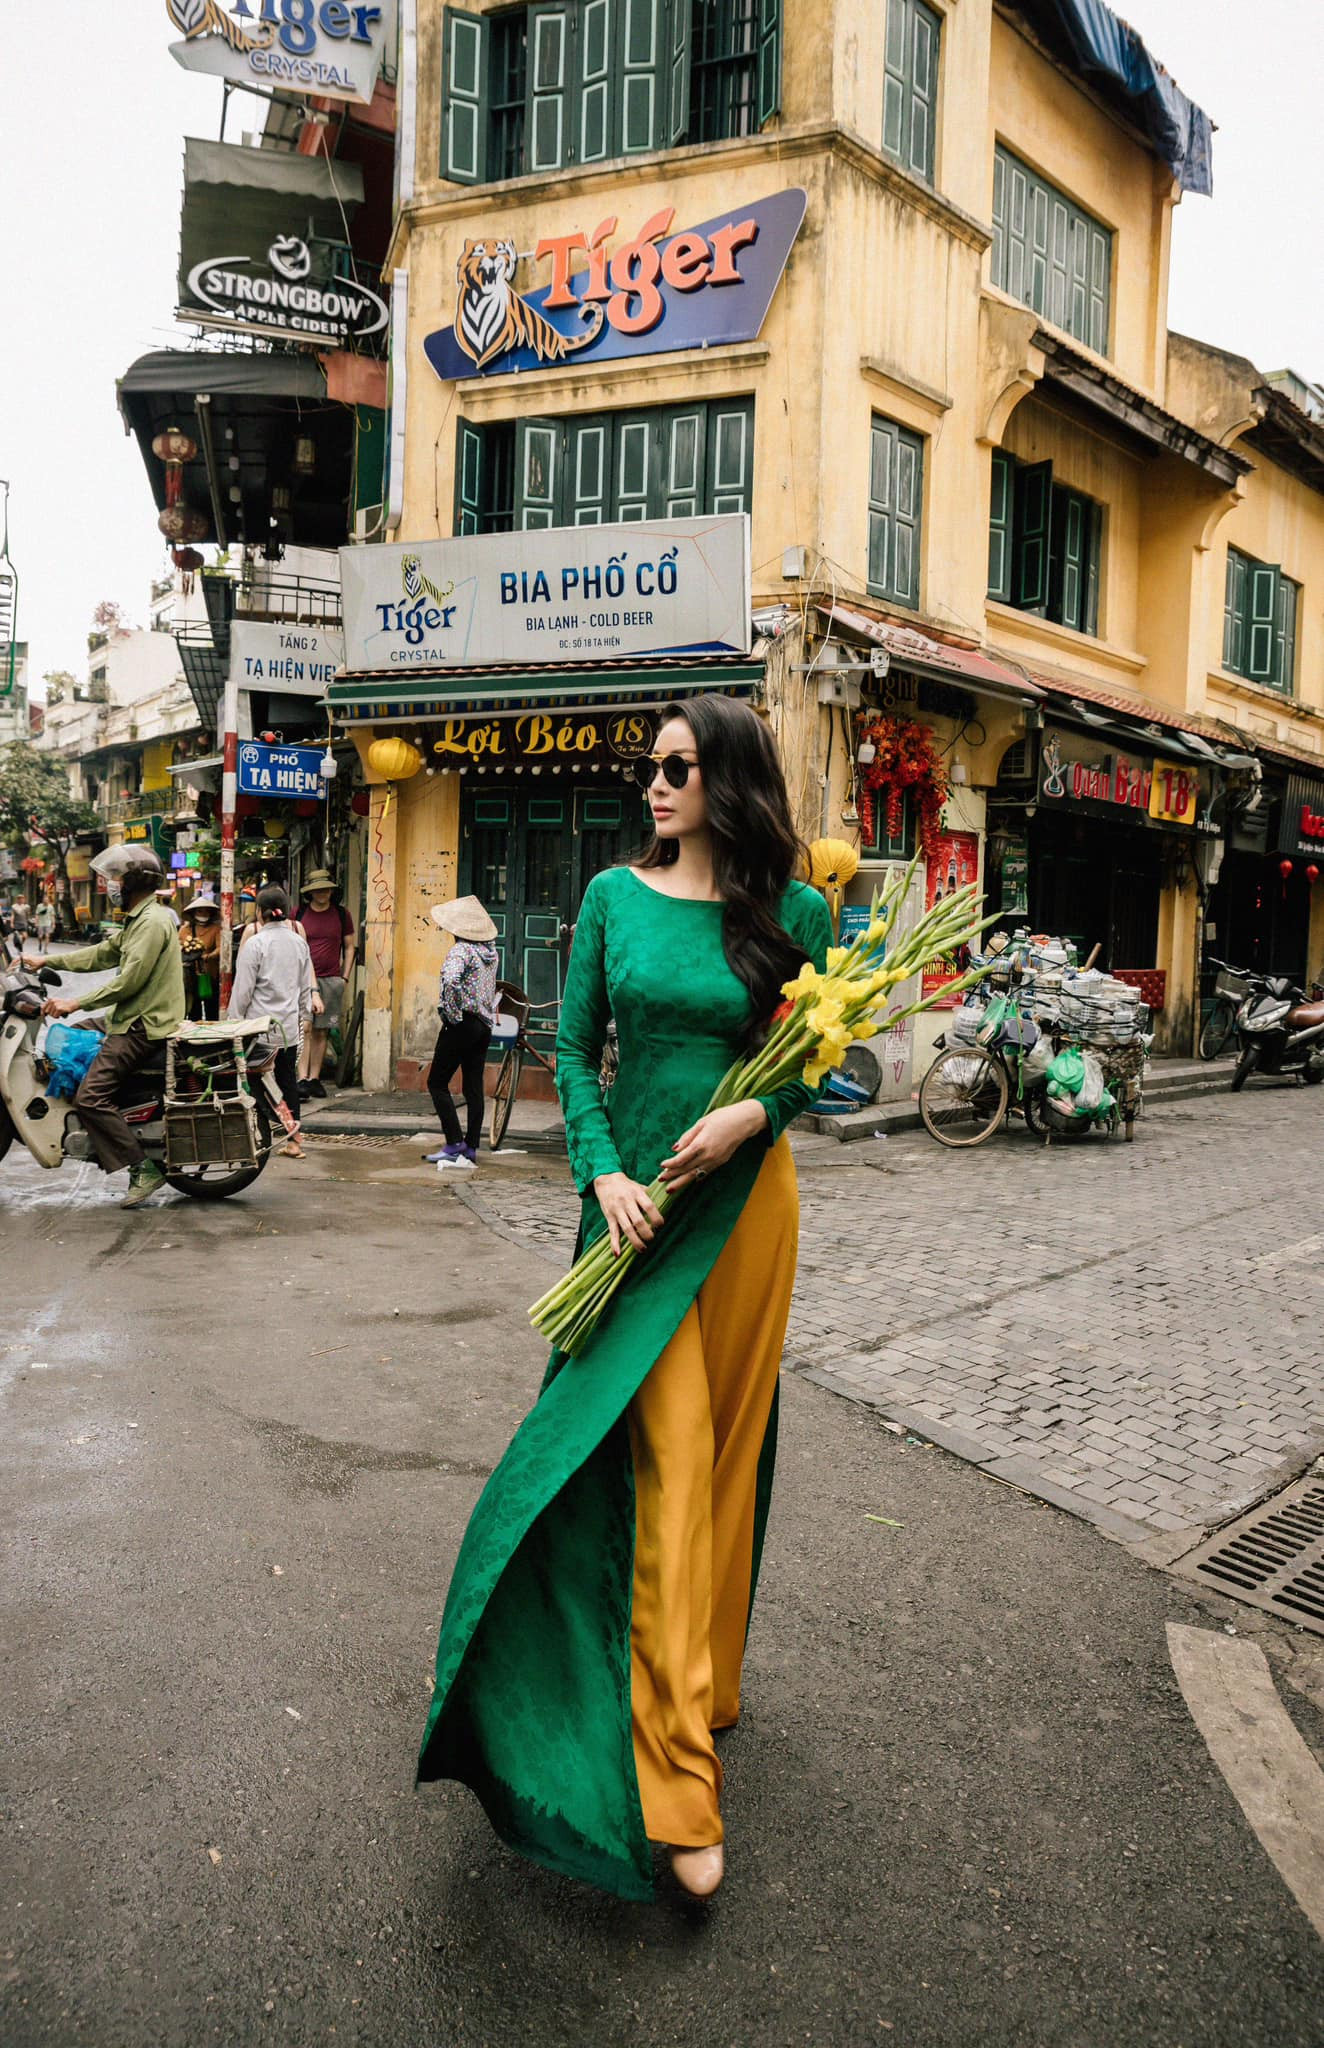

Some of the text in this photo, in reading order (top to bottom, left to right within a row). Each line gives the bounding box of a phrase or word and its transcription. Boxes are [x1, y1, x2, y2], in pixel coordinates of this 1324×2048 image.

[251, 51, 357, 88] CRYSTAL
[535, 207, 758, 334] Tiger
[235, 304, 348, 335] APPLE CIDERS
[500, 546, 679, 604] BIA PHỐ CỔ
[376, 597, 457, 645] Tiger
[526, 617, 545, 631] BIA
[548, 615, 578, 632] LẠNH
[590, 612, 619, 627] COLD
[624, 611, 653, 625] BEER
[311, 638, 318, 651] 2
[390, 649, 446, 662] CRYSTAL
[584, 639, 592, 648] 18
[245, 657, 336, 682] TẠ HIỆN VIE
[433, 715, 644, 762] Lợi Béo 18
[269, 752, 299, 766] PHỐ
[250, 768, 318, 792] TẠ HIỆN
[1114, 754, 1151, 809] Bar
